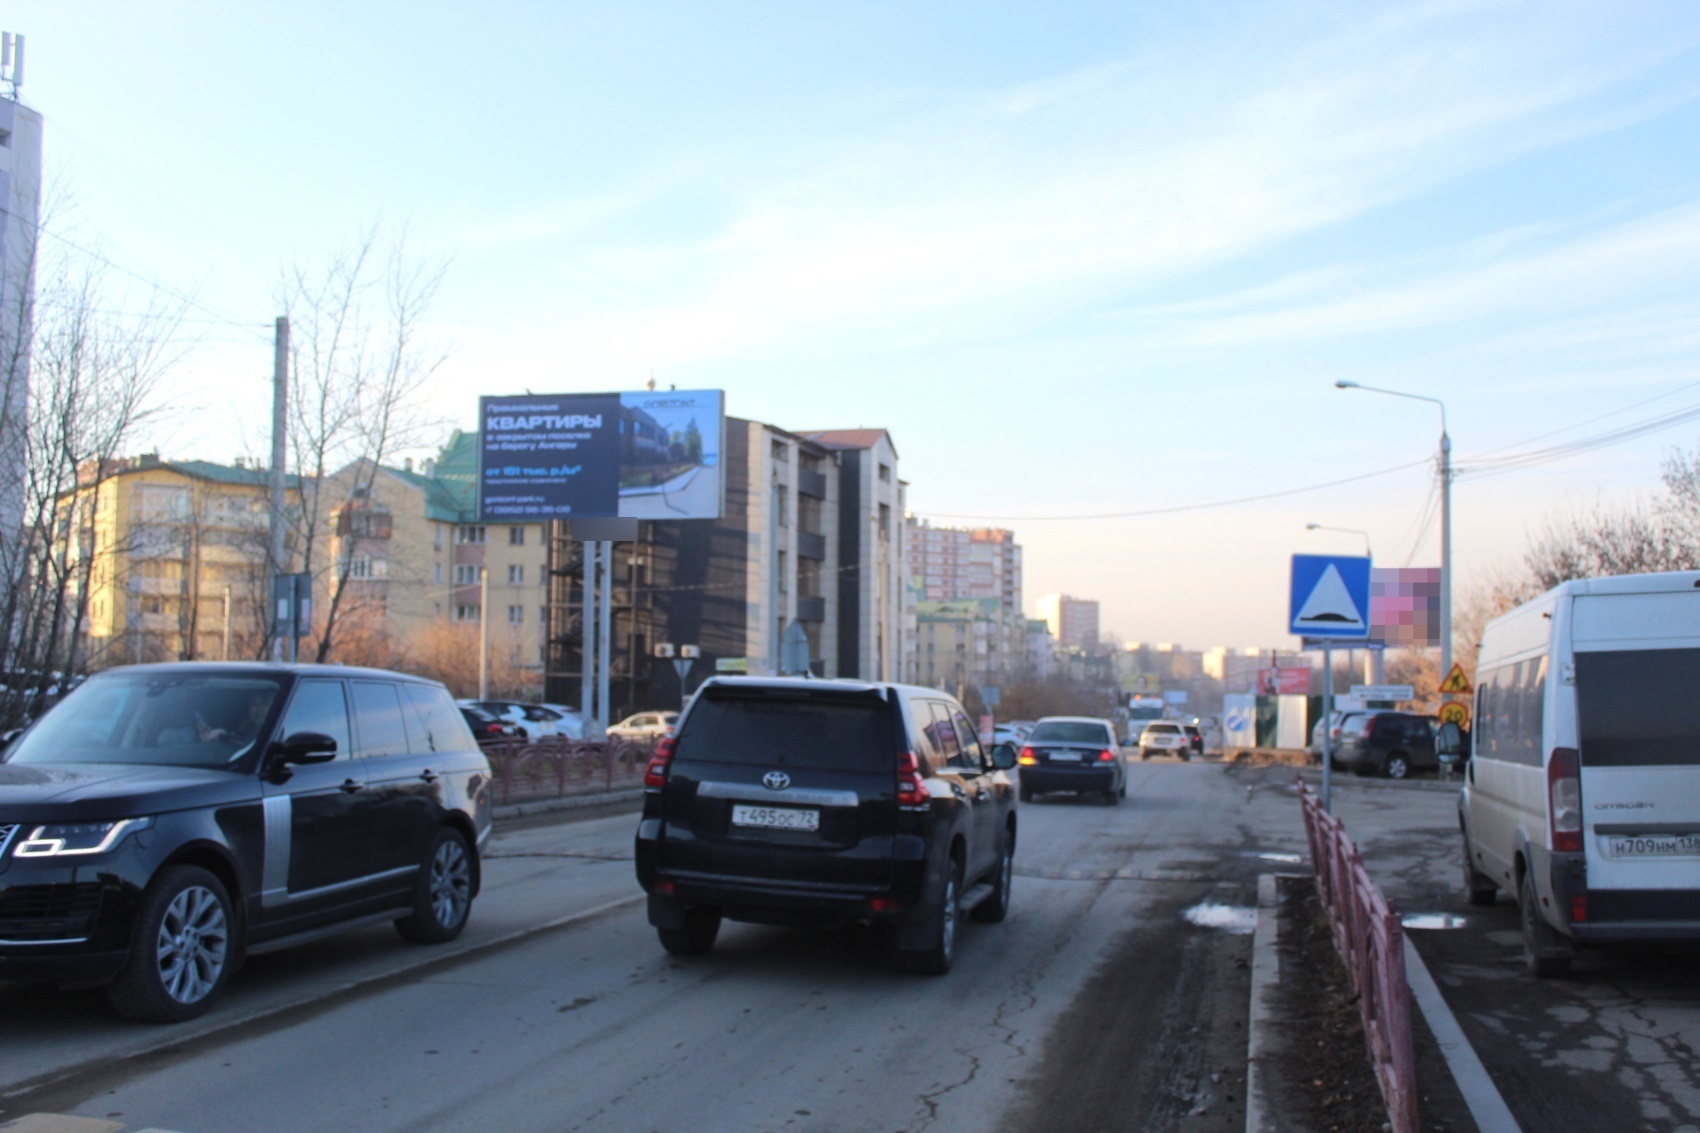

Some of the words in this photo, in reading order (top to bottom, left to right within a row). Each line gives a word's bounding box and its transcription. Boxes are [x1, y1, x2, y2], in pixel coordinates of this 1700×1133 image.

[486, 414, 602, 431] КВАРТИРЫ
[495, 433, 546, 442] закрытом
[501, 442, 536, 452] берегу
[538, 441, 577, 450] Ангары
[485, 468, 500, 476] от
[523, 467, 548, 476] тыс.
[1446, 709, 1462, 721] 20
